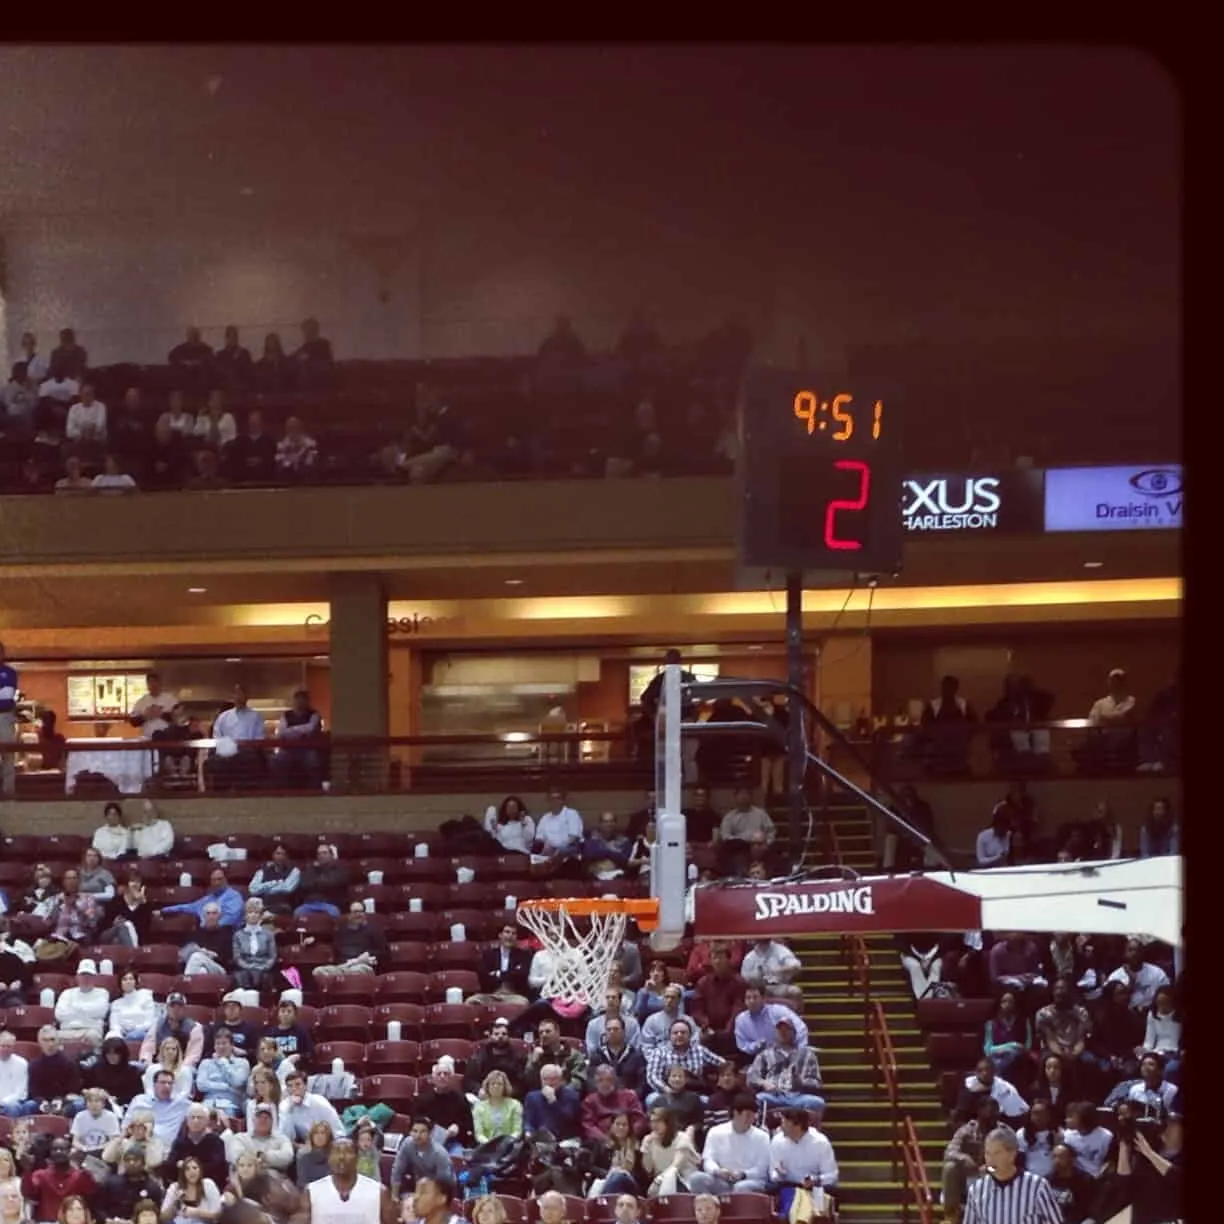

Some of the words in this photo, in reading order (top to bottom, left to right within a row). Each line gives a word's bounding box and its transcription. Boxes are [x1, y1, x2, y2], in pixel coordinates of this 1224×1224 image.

[794, 390, 882, 440] 9:51
[825, 459, 870, 549] 2
[902, 478, 1001, 515] XUS
[1095, 502, 1160, 518] Draisin
[902, 513, 997, 530] HARLESTON
[755, 886, 875, 920] SPALDING
